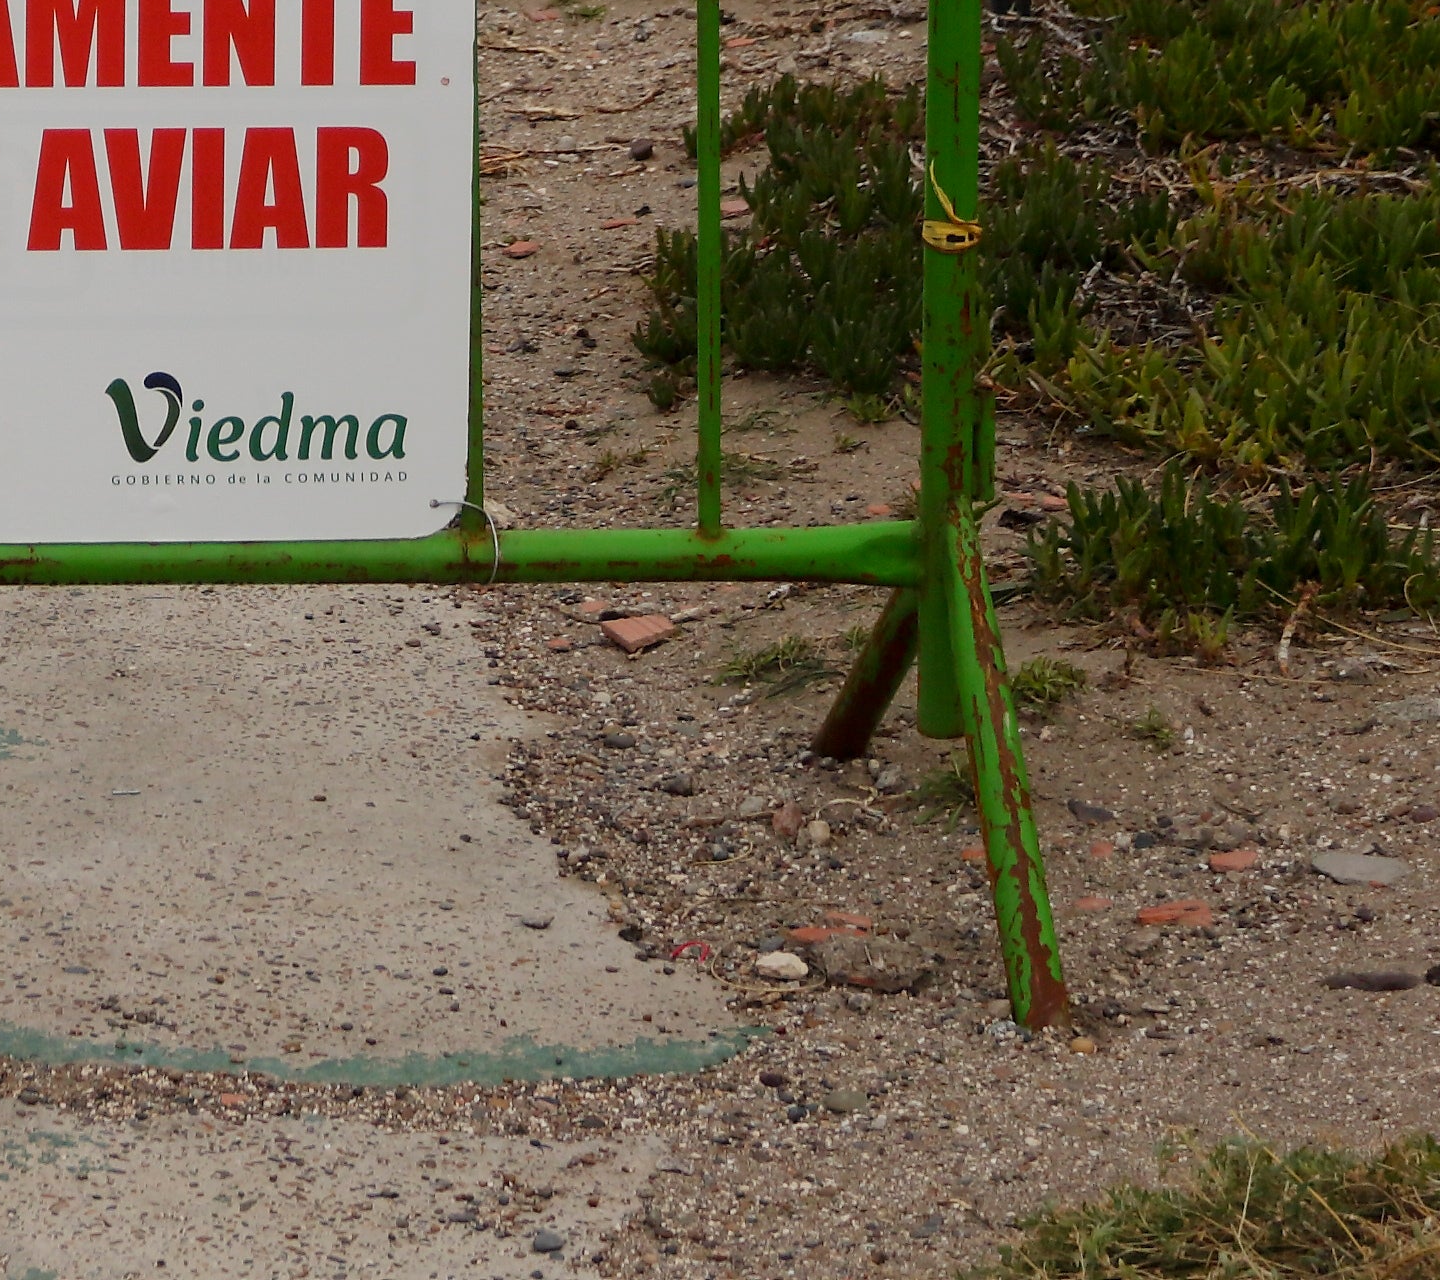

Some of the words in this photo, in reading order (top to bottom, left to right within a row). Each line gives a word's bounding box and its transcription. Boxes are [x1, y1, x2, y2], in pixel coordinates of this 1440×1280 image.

[28, 127, 388, 250] AVIAR
[104, 371, 408, 463] Viedma
[111, 474, 216, 486] GOBIERNO
[227, 473, 247, 485] de
[256, 472, 271, 485] la
[284, 471, 408, 484] COMUNIDAD
